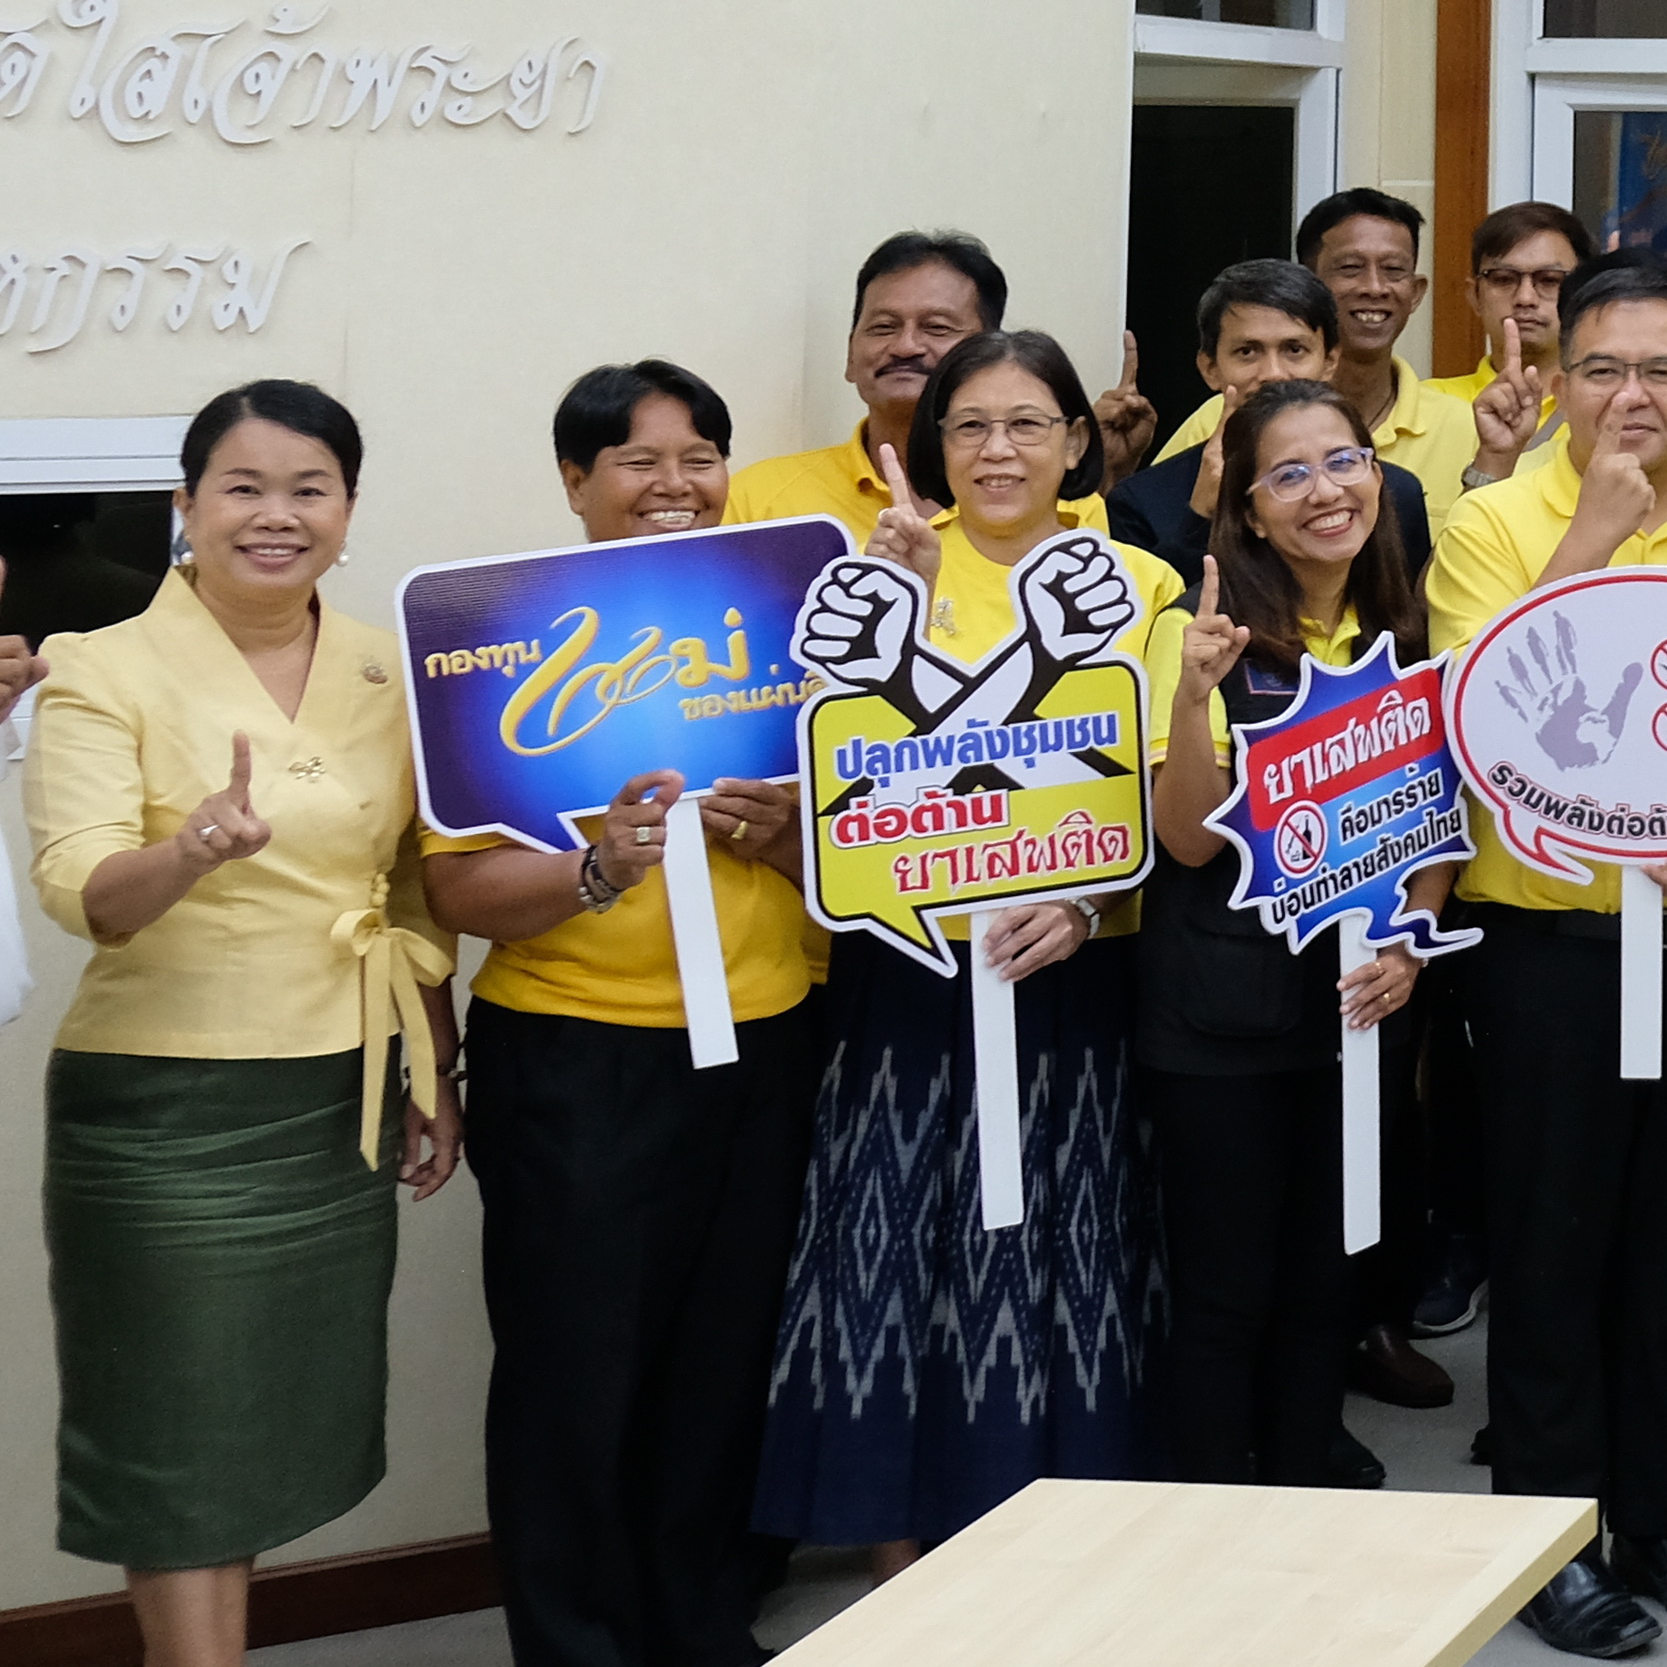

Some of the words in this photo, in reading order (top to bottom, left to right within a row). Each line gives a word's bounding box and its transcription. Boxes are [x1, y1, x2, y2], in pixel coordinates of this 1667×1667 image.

[424, 638, 542, 678] กองทุน
[836, 712, 1118, 789] ปลุกพลังชุมชน
[1263, 690, 1432, 805] ยาเสพติด
[835, 790, 1005, 844] ต่อต้าน
[1341, 764, 1442, 842] คือมารร้าย
[893, 810, 1132, 893] ยาเสพติด
[1271, 809, 1462, 925] บ่อนทำลายสังคมไทย
